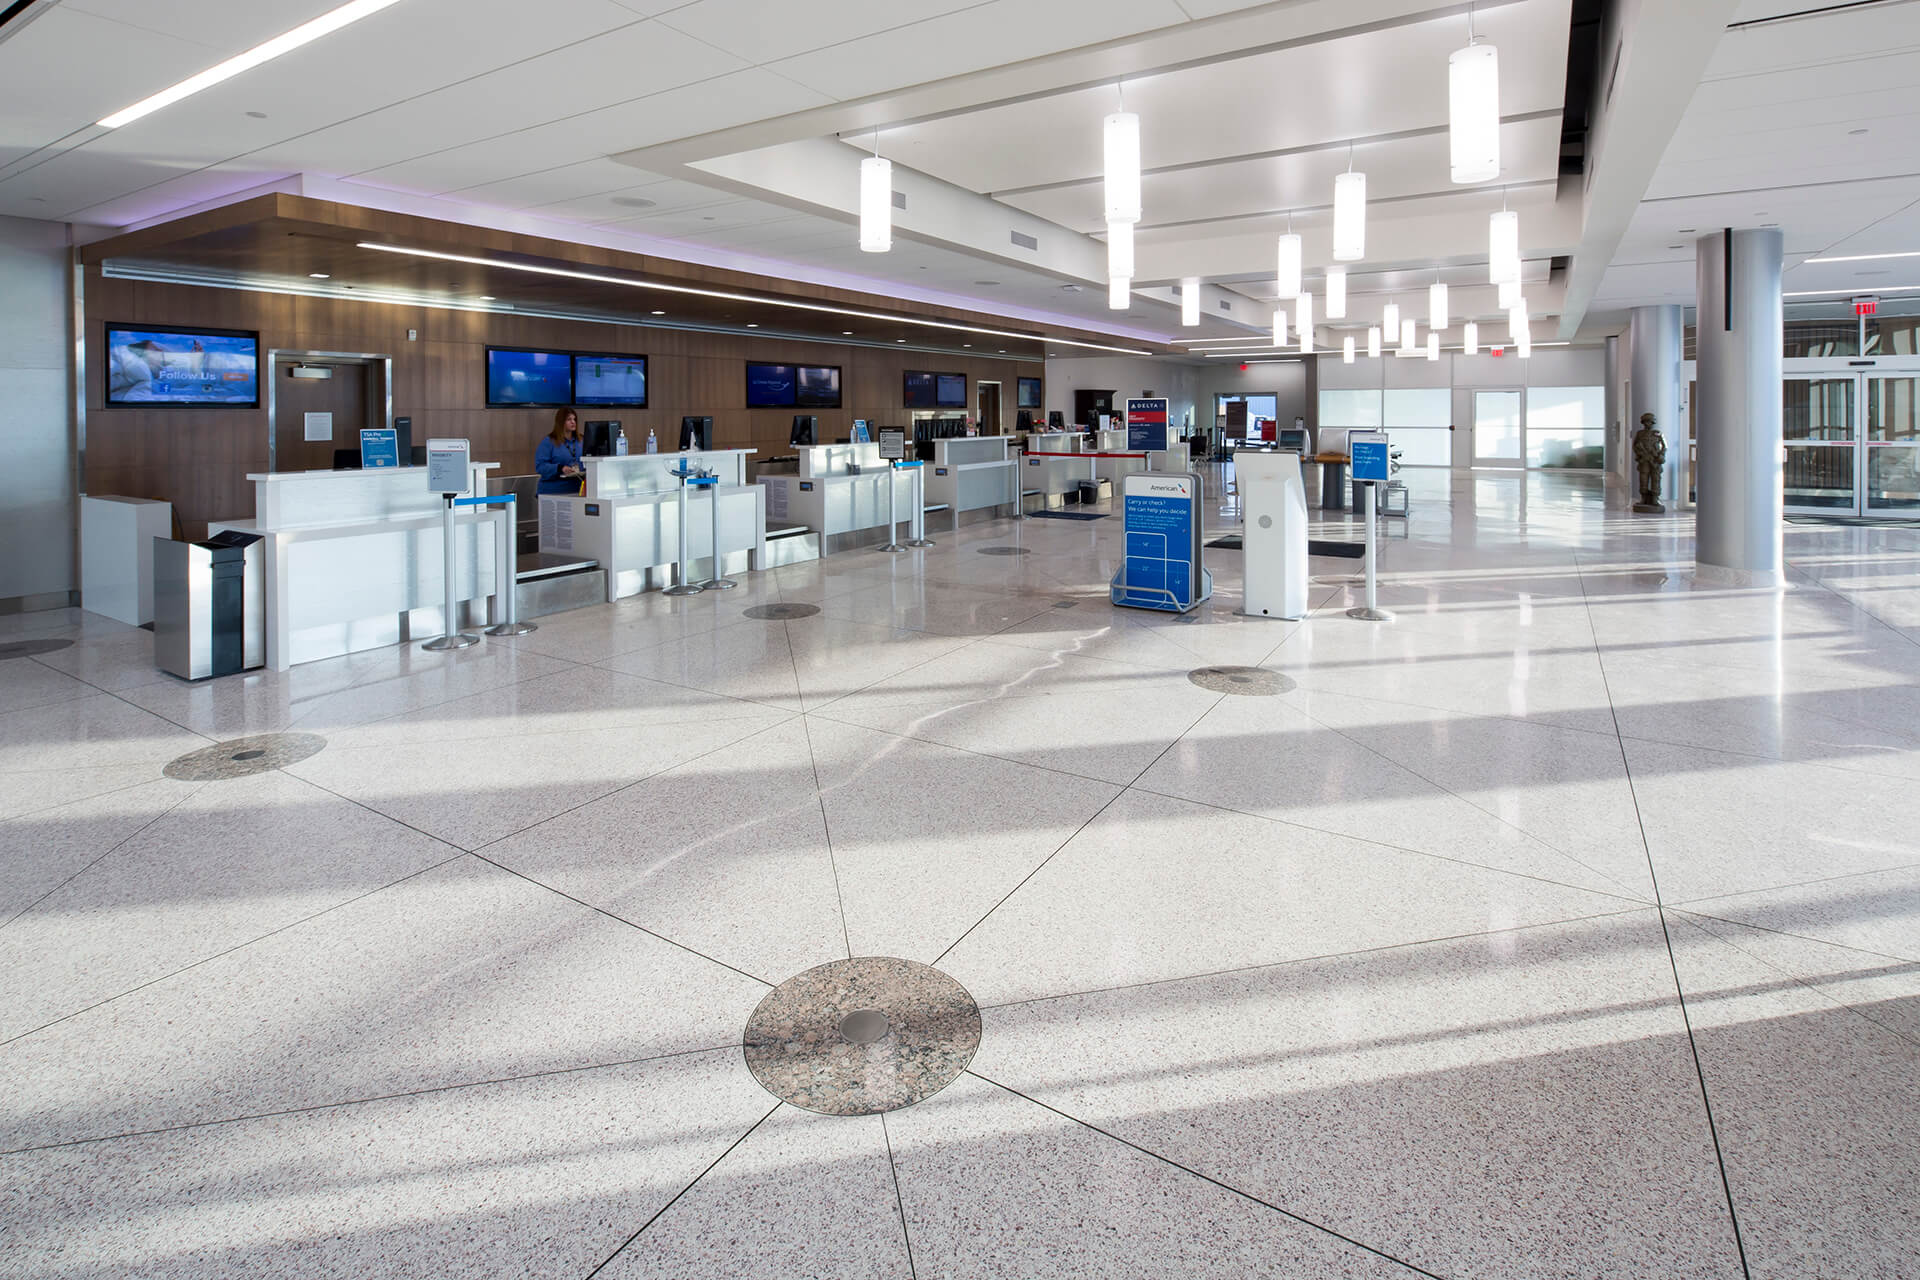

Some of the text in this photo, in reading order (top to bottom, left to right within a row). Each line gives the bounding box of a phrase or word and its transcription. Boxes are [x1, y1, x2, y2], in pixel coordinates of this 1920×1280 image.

[1855, 302, 1877, 315] EXIT
[159, 370, 198, 380] Follow
[200, 371, 217, 380] Us
[1150, 484, 1178, 492] American
